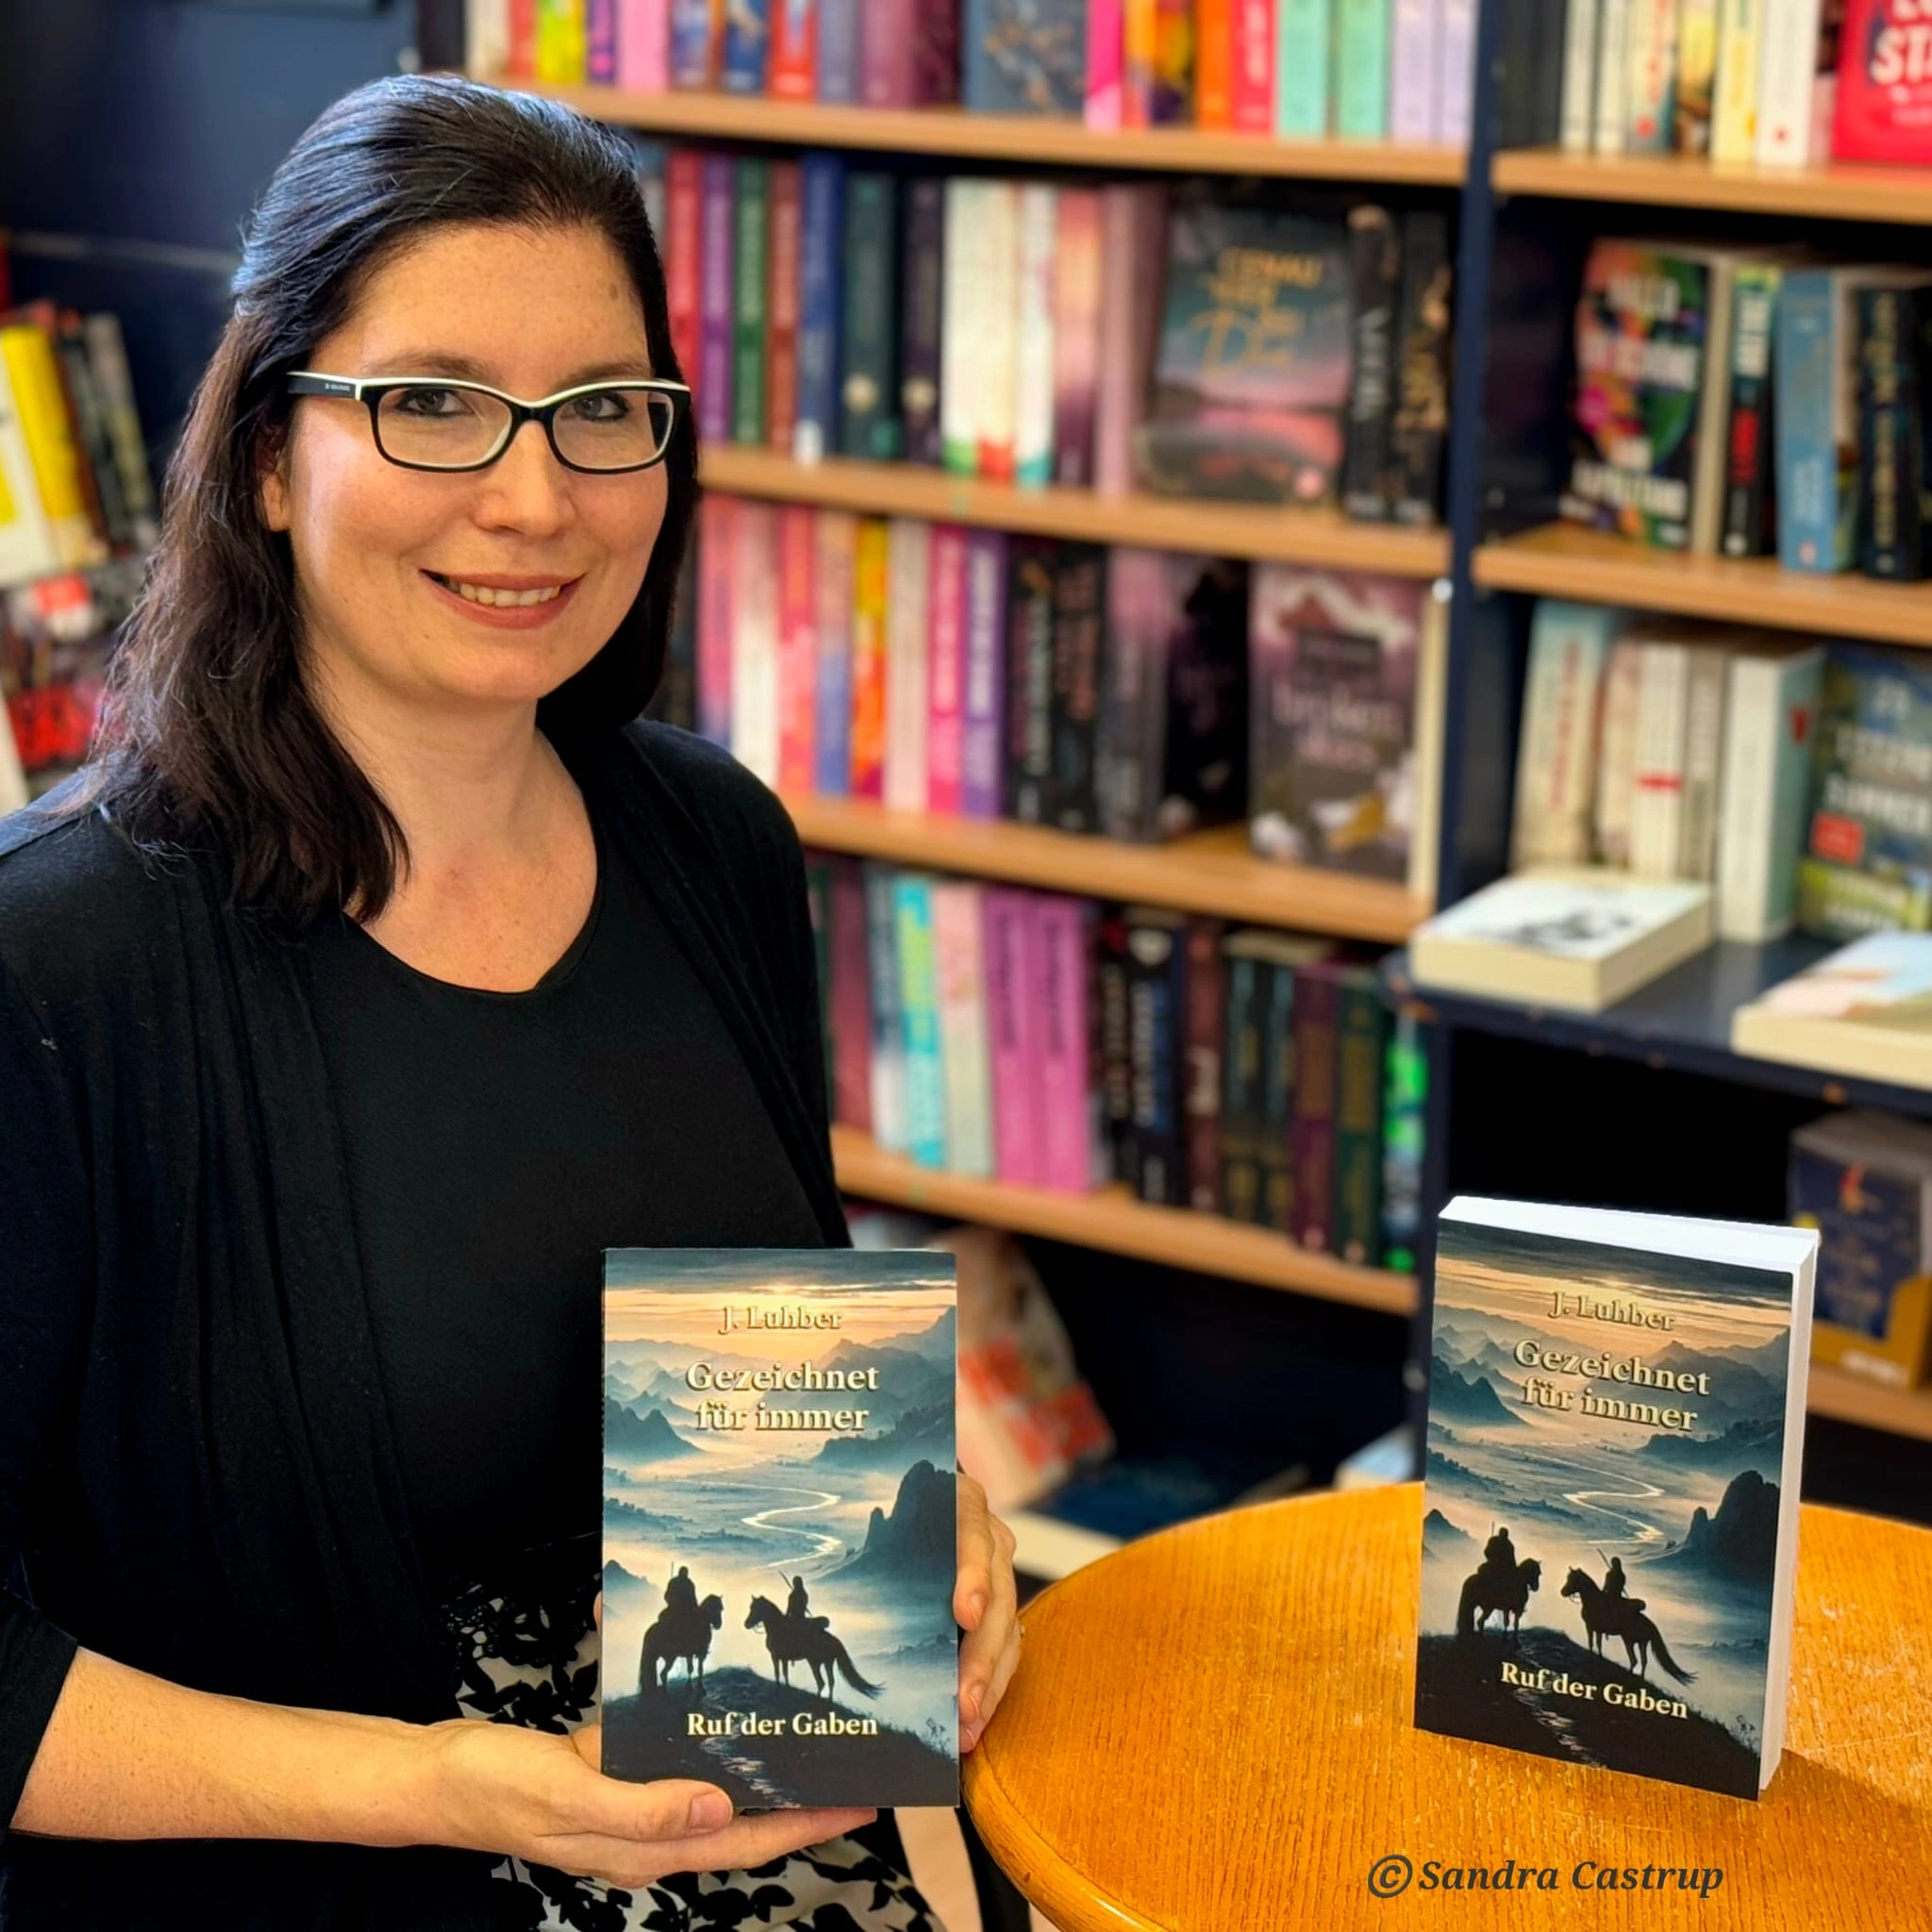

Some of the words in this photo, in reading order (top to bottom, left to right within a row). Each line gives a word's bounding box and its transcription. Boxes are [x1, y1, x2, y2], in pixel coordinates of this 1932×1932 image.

[719, 1306, 740, 1335] J.
[747, 1306, 841, 1329] Luhber
[1548, 1291, 1570, 1319] J.
[1577, 1294, 1676, 1331] Luhber
[687, 1359, 879, 1391] Gezeichnet
[1514, 1340, 1710, 1396] Gezeichnet
[696, 1400, 748, 1430] für
[756, 1402, 869, 1430] immer
[1522, 1376, 1575, 1411] für
[1580, 1388, 1698, 1432] immer
[1500, 1661, 1551, 1690] Ruf
[1552, 1673, 1597, 1701] der
[1603, 1683, 1690, 1720] Gaben
[687, 1711, 738, 1736] Ruf
[741, 1711, 786, 1736] der
[791, 1711, 878, 1736] Gaben
